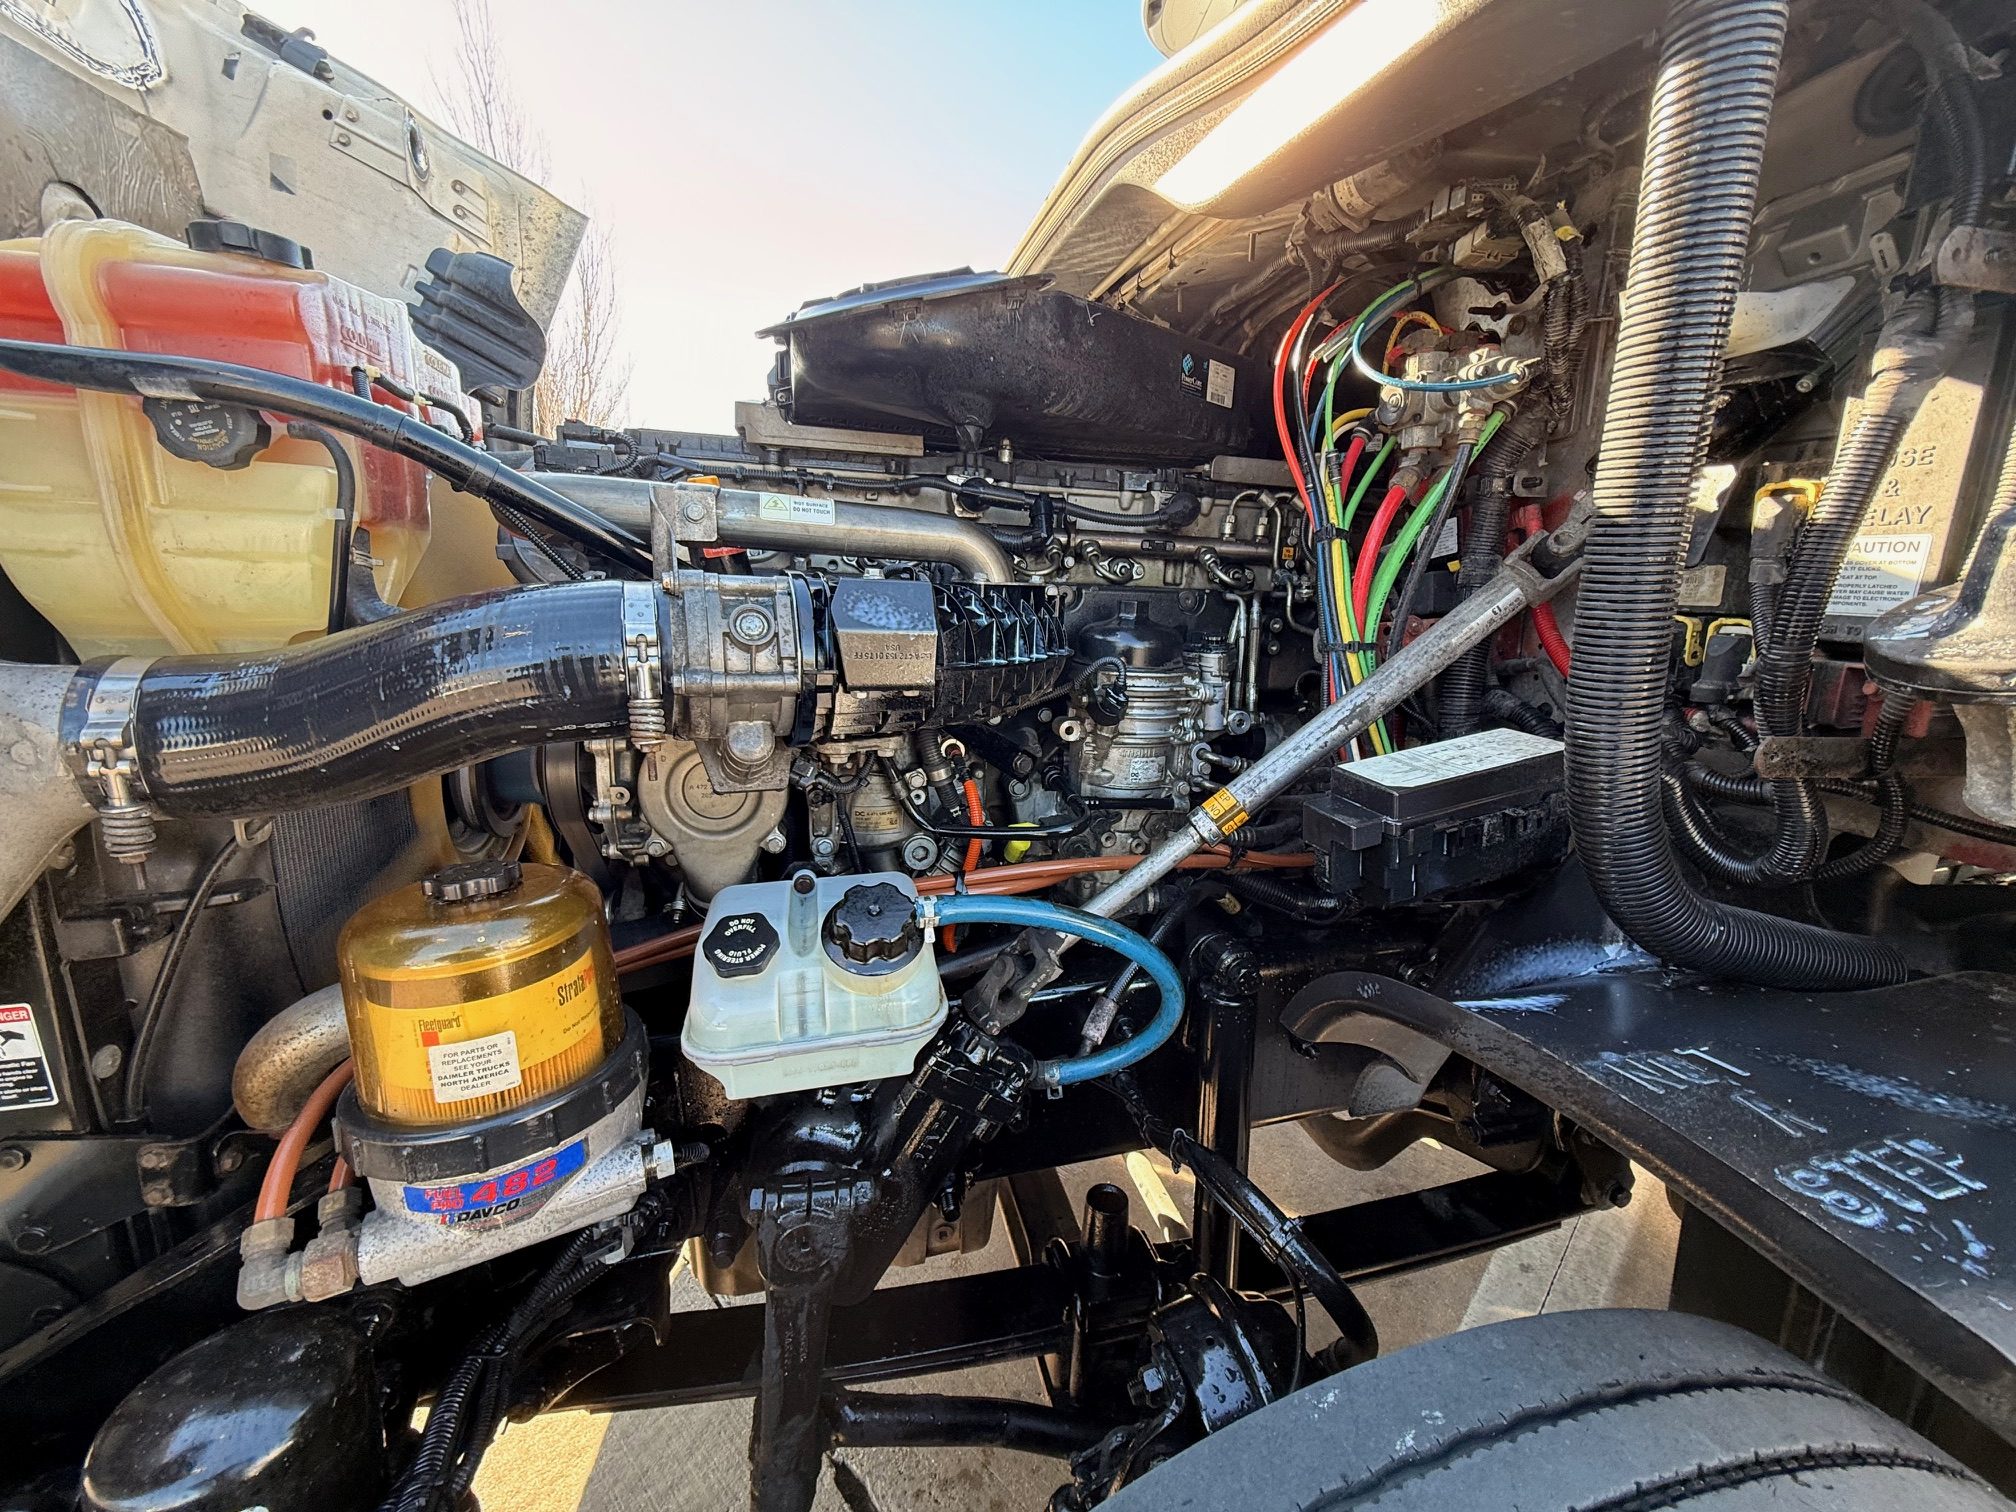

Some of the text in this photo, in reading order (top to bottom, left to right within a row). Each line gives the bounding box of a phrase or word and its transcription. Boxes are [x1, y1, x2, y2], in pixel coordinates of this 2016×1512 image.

[1861, 505, 1933, 527] ELAY
[1851, 541, 1921, 554] AUTION
[724, 924, 757, 936] OVERFILL
[729, 919, 740, 927] DO
[714, 943, 767, 964] POWER STEERING
[728, 948, 752, 957] FLUID
[0, 1010, 28, 1022] GER
[418, 1015, 461, 1032] Fleetguard
[441, 1049, 503, 1066] REPLACEMENTS
[460, 1046, 486, 1056] PARTS
[437, 1070, 474, 1081] DAIMLER
[476, 1061, 511, 1074] TRUCKS
[470, 1059, 492, 1068] YOUR
[440, 1069, 510, 1088] NORTH AMERICA
[460, 1080, 491, 1092] DEALER
[470, 1156, 559, 1204] 482
[456, 1198, 521, 1223] DAVCO
